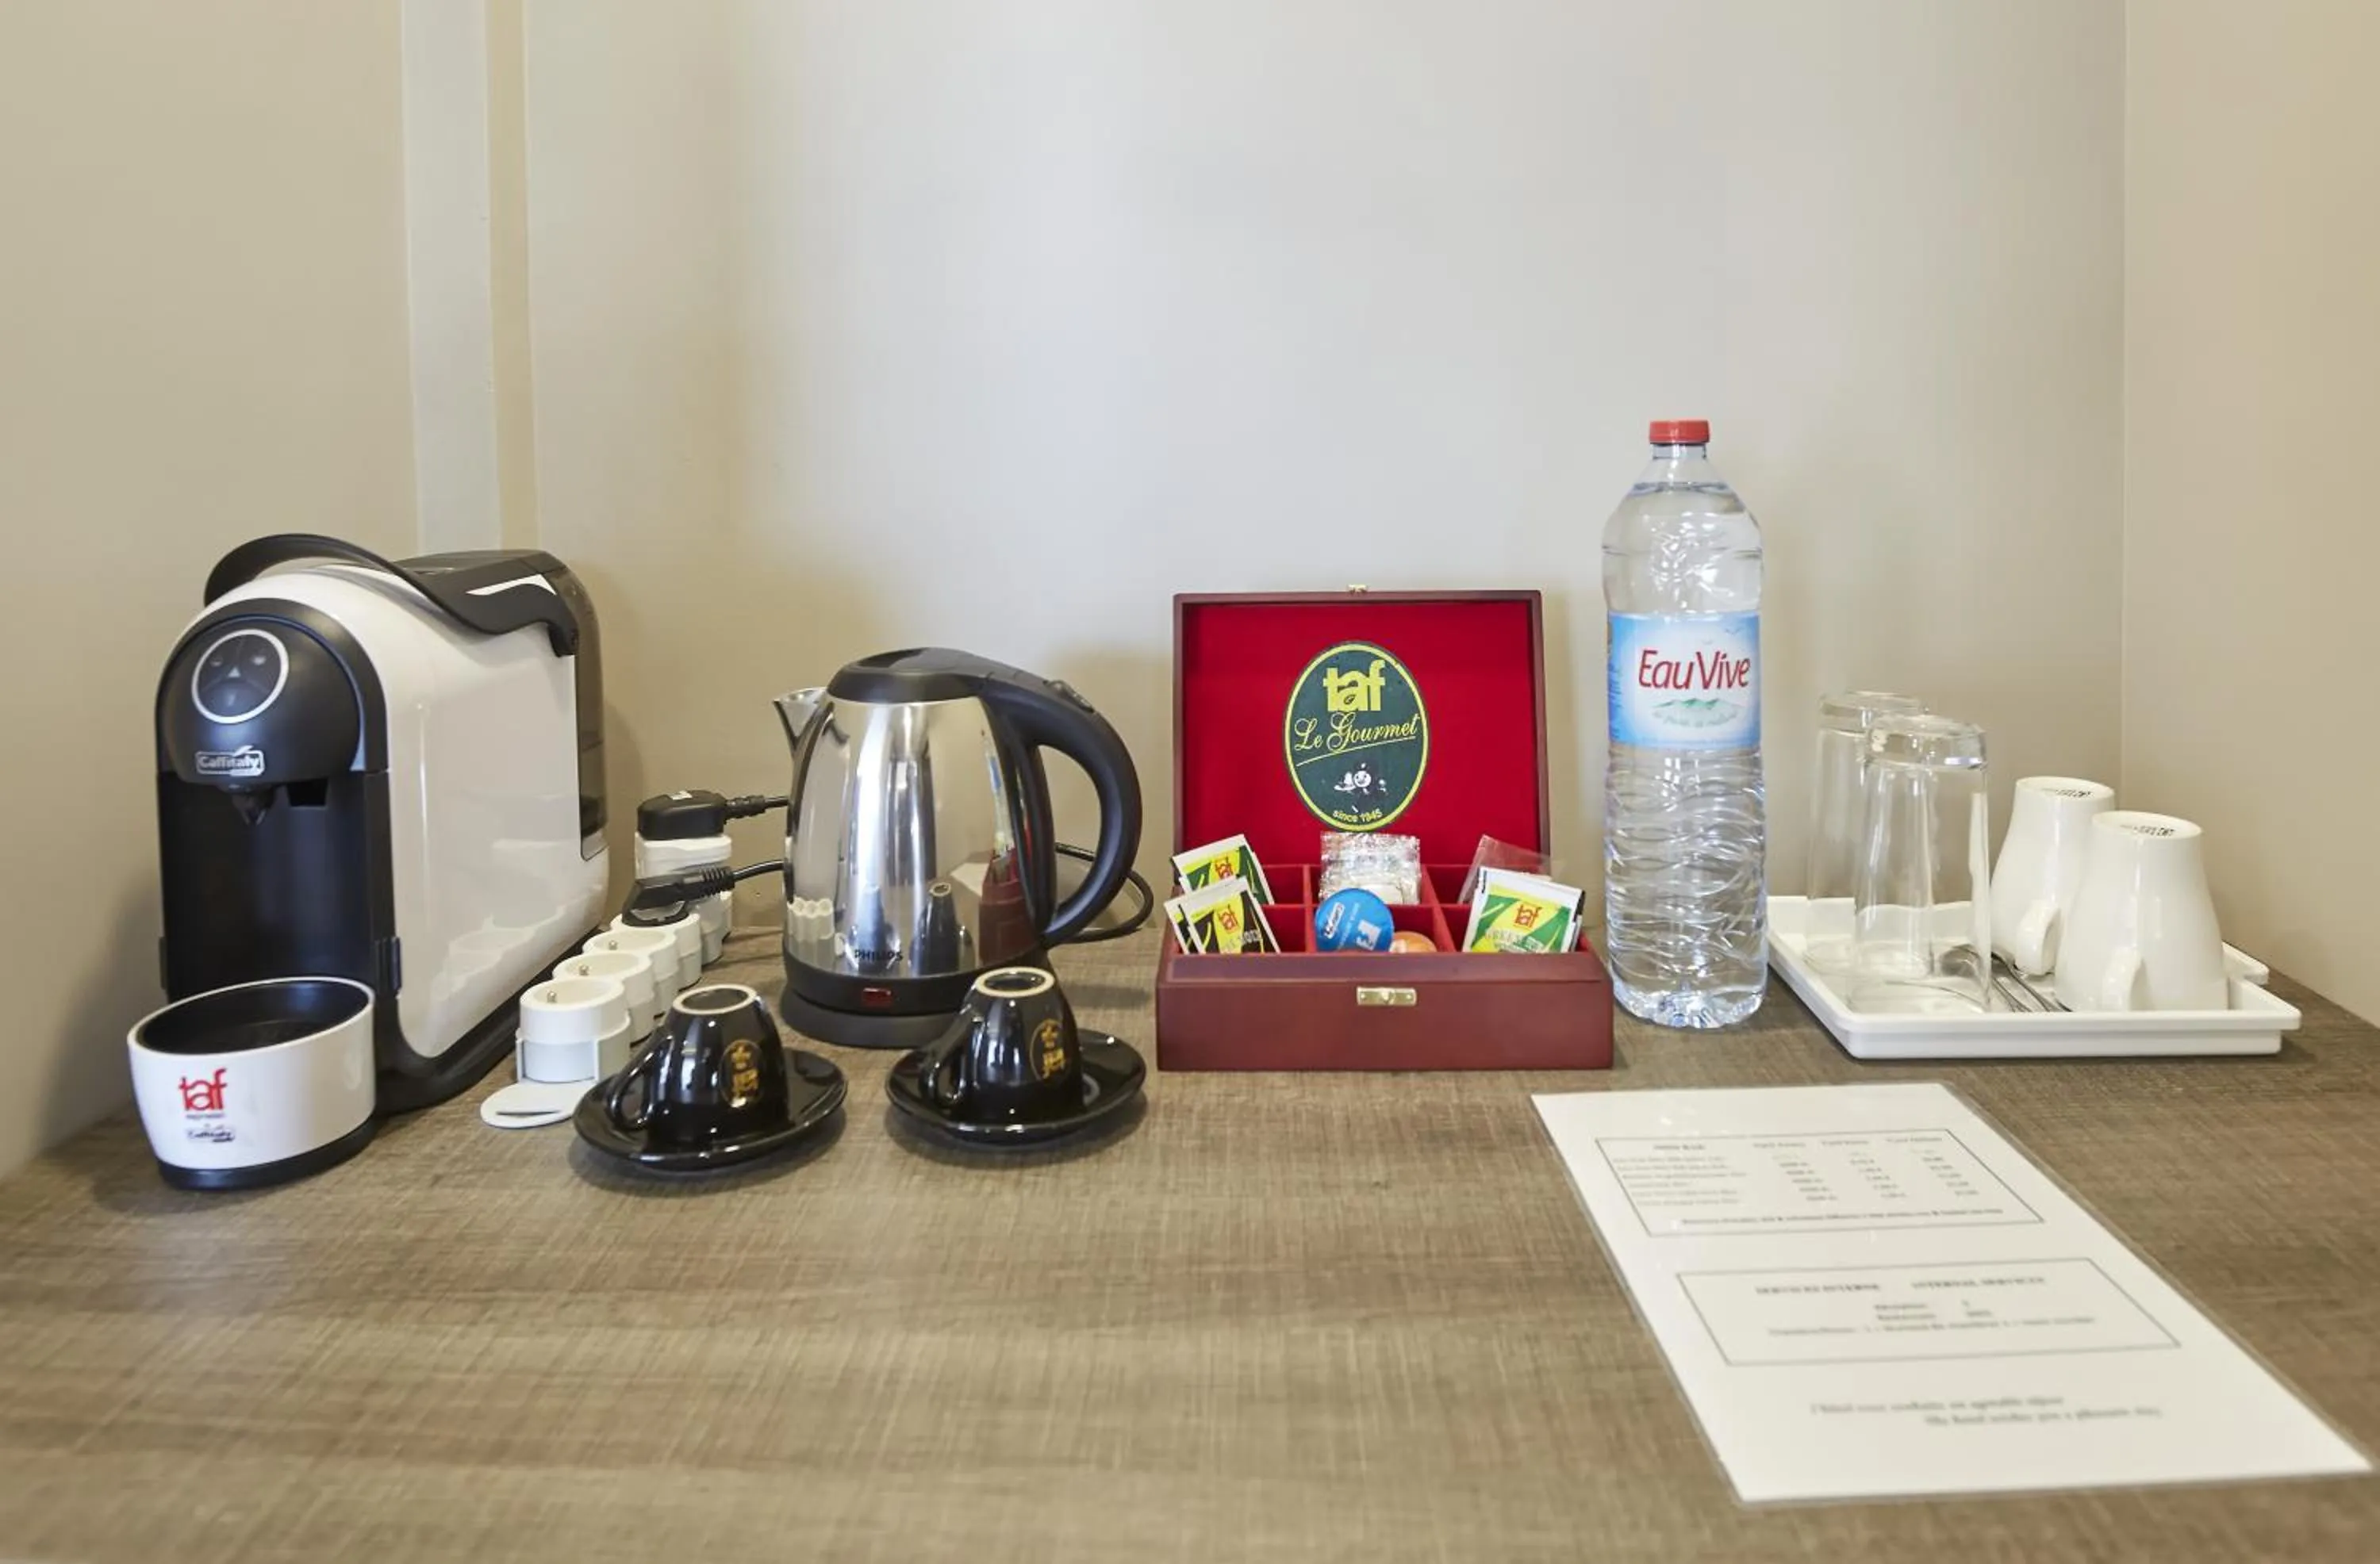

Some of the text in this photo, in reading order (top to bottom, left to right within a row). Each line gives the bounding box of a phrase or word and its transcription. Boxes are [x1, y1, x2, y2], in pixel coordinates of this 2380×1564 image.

[1322, 659, 1385, 712] taf
[1294, 711, 1420, 753] Le Gourmet
[1333, 810, 1357, 822] since
[178, 1068, 228, 1110] taf
